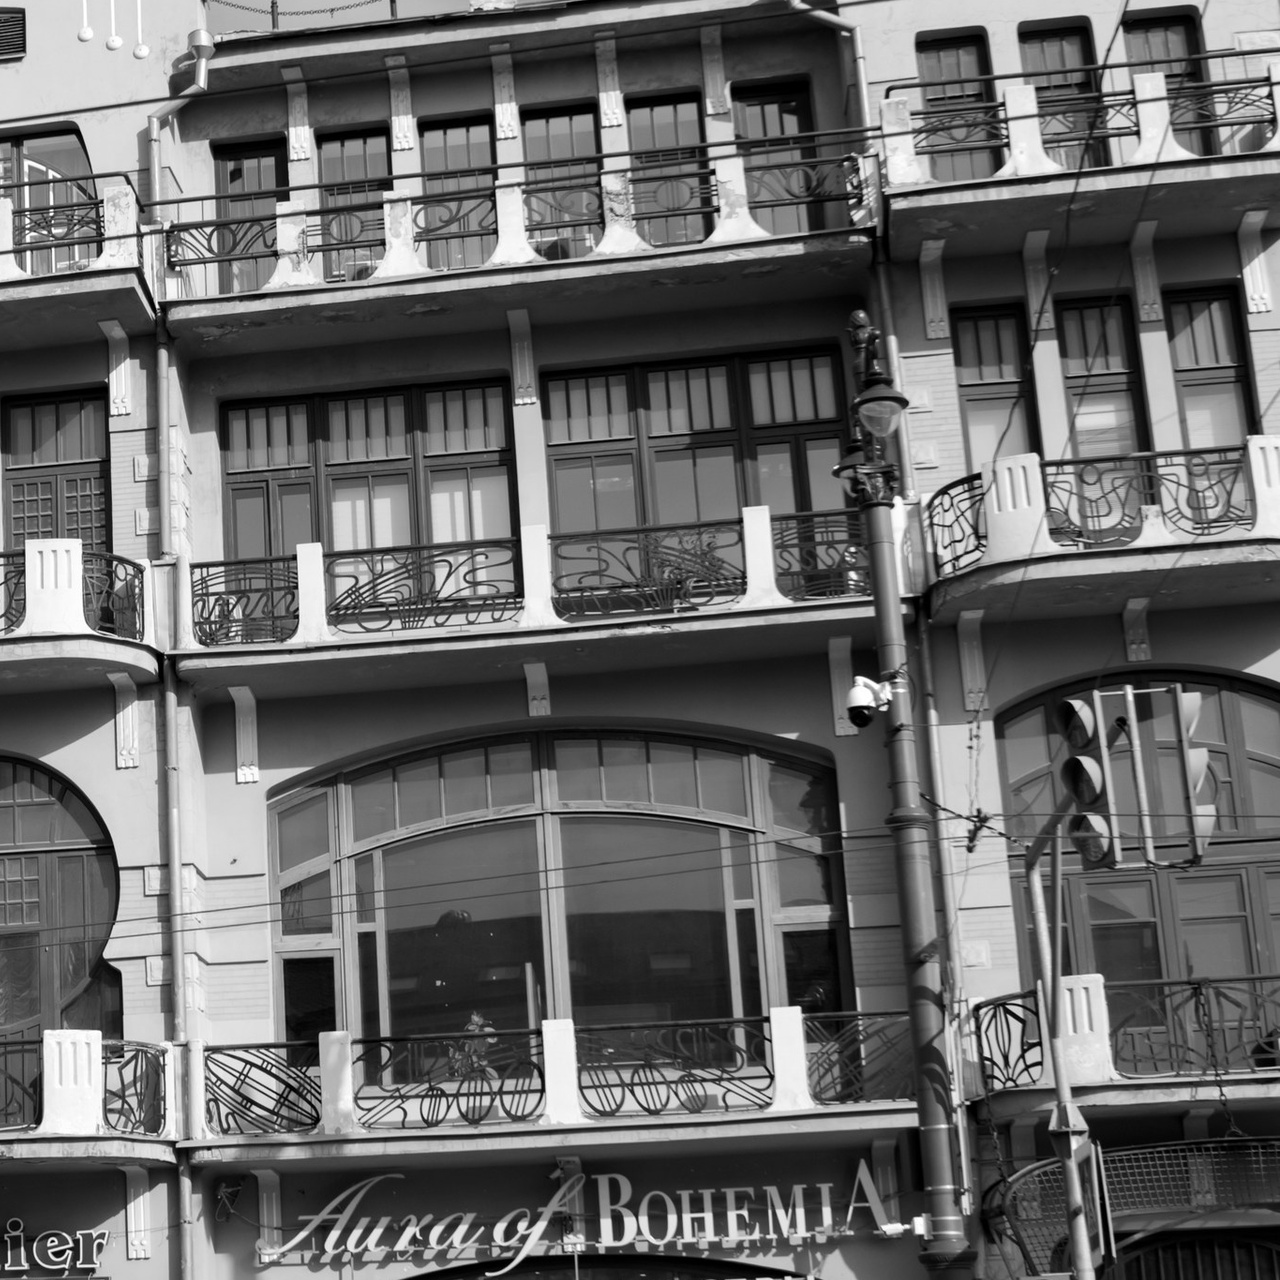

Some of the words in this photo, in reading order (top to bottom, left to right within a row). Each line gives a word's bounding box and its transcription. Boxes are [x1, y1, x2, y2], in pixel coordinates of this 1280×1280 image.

[255, 1173, 484, 1255] Aura
[485, 1173, 586, 1277] of
[591, 1158, 892, 1247] BOHEMIA
